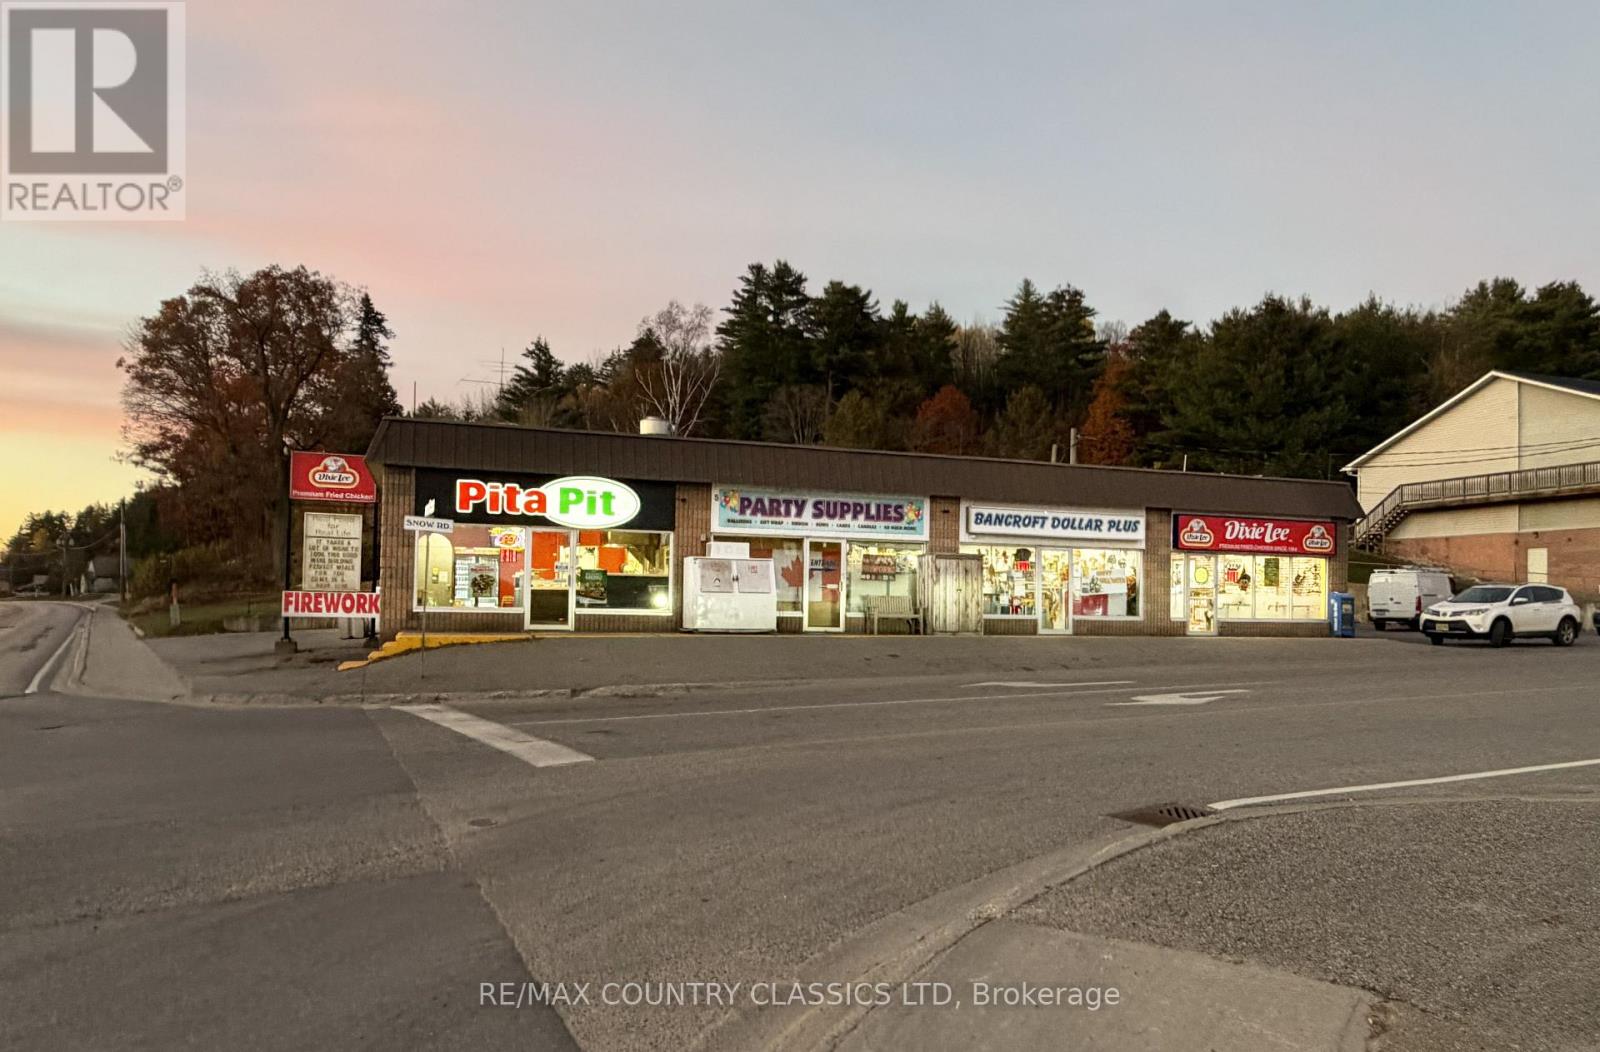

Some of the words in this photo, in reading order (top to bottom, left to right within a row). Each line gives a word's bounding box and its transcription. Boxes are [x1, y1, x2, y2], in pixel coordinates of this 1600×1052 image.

[326, 491, 344, 499] Fried
[345, 492, 374, 500] Chicken
[457, 480, 548, 514] Pita
[558, 486, 616, 516] Pit
[738, 497, 808, 519] PARTY
[812, 499, 905, 523] SUPPLIES
[406, 519, 434, 528] SNOW
[437, 522, 450, 530] RD
[974, 512, 1049, 529] BANCROFT
[1051, 516, 1103, 533] DOLLAR
[1107, 519, 1141, 533] PLUS
[1224, 520, 1265, 541] Dixie
[1264, 522, 1291, 544] Lee
